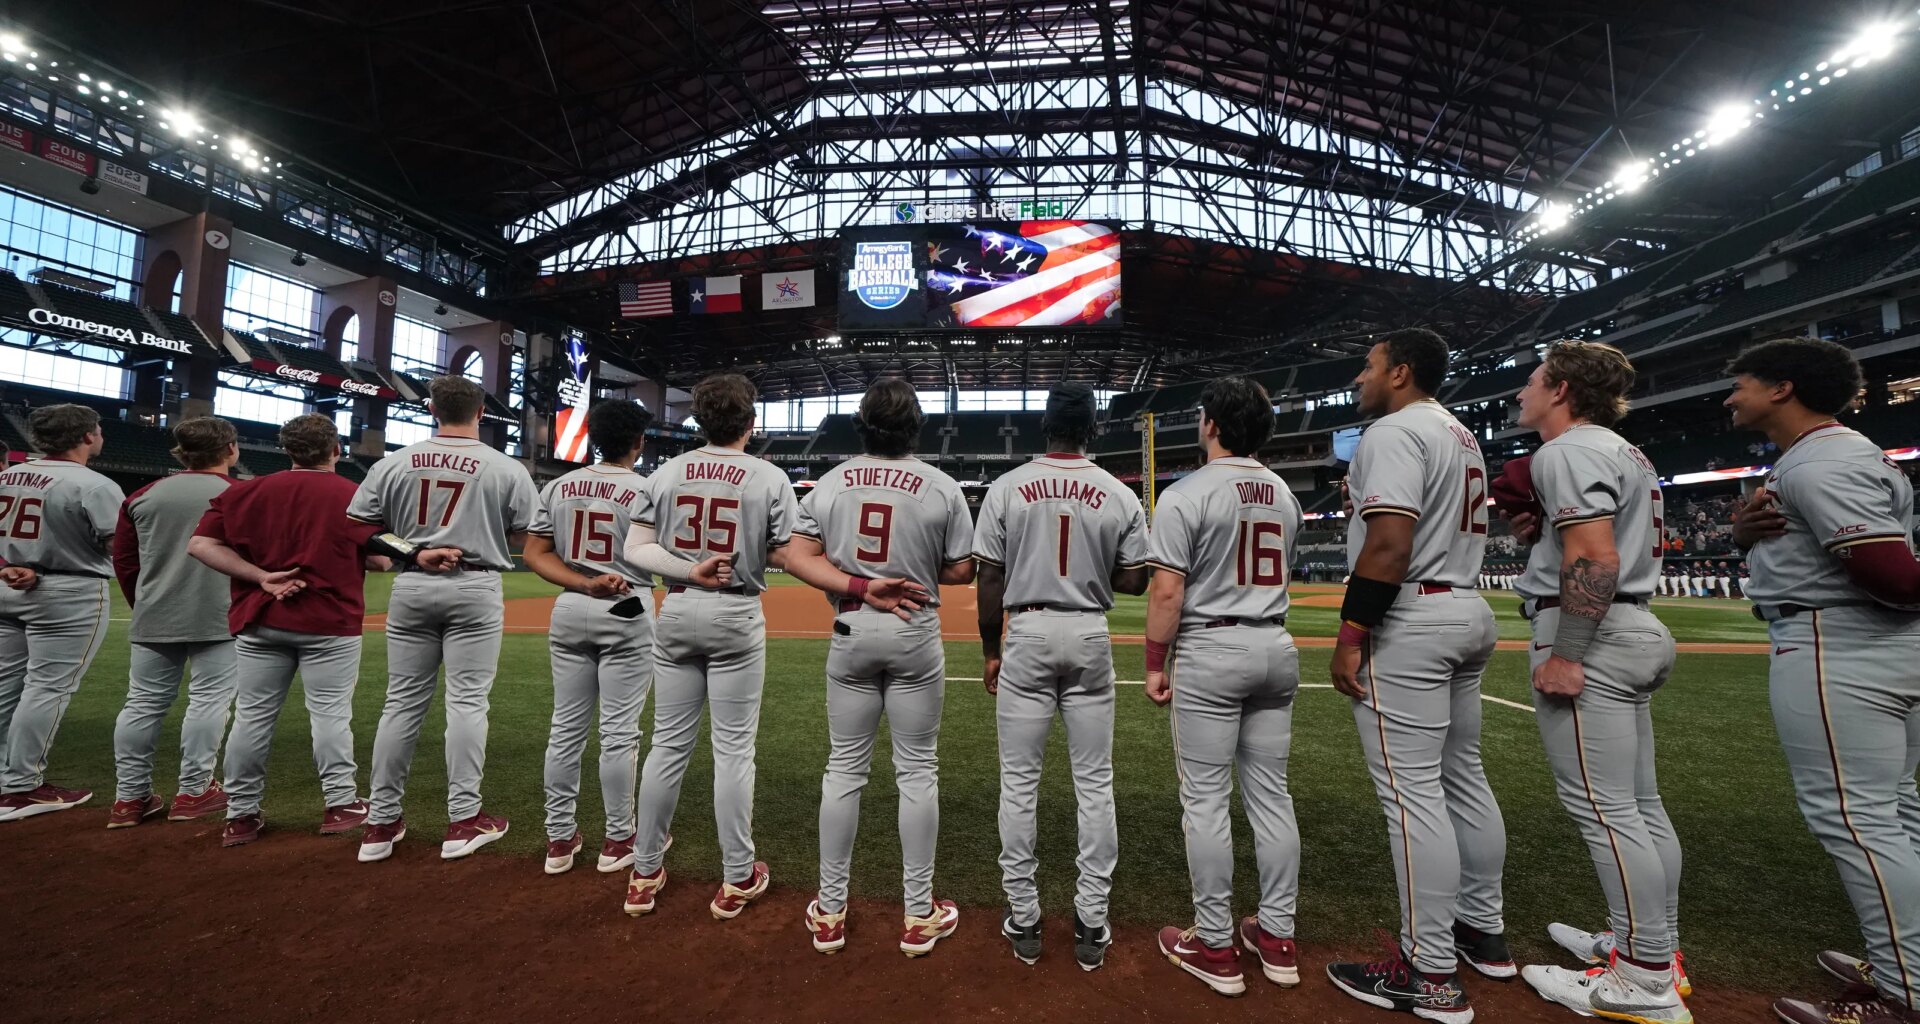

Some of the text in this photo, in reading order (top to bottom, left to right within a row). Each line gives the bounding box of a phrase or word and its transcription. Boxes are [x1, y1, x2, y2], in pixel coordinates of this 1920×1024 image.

[49, 141, 86, 162] 2016
[105, 162, 141, 183] 2023
[922, 200, 1063, 220] Globe Life Field
[213, 233, 223, 245] 7
[855, 253, 912, 271] COLLEGE
[850, 269, 917, 289] BASEBALL
[866, 286, 900, 295] SERIES
[381, 292, 394, 304] 29
[140, 331, 193, 354] Bank
[275, 364, 322, 384] Coca-Cola
[340, 378, 381, 397] Coca-Cola
[411, 453, 480, 475] BUCKLES
[686, 462, 746, 486] BAVARO
[0, 472, 54, 490] PUTNAM
[843, 467, 924, 495] STUETZER
[418, 478, 466, 527] 17
[561, 480, 637, 508] PAULINO JR
[1017, 478, 1107, 511] WILLIAMS
[1235, 481, 1275, 506] DOWD
[1460, 464, 1487, 535] 12
[0, 495, 42, 540] 26
[1556, 506, 1579, 516] ACC
[674, 494, 739, 554] 35
[856, 502, 893, 563] 9
[1651, 489, 1663, 558] 5
[1834, 523, 1868, 536] ACC
[571, 509, 615, 563] 15
[1058, 514, 1071, 577] 1
[1237, 519, 1284, 587] 16
